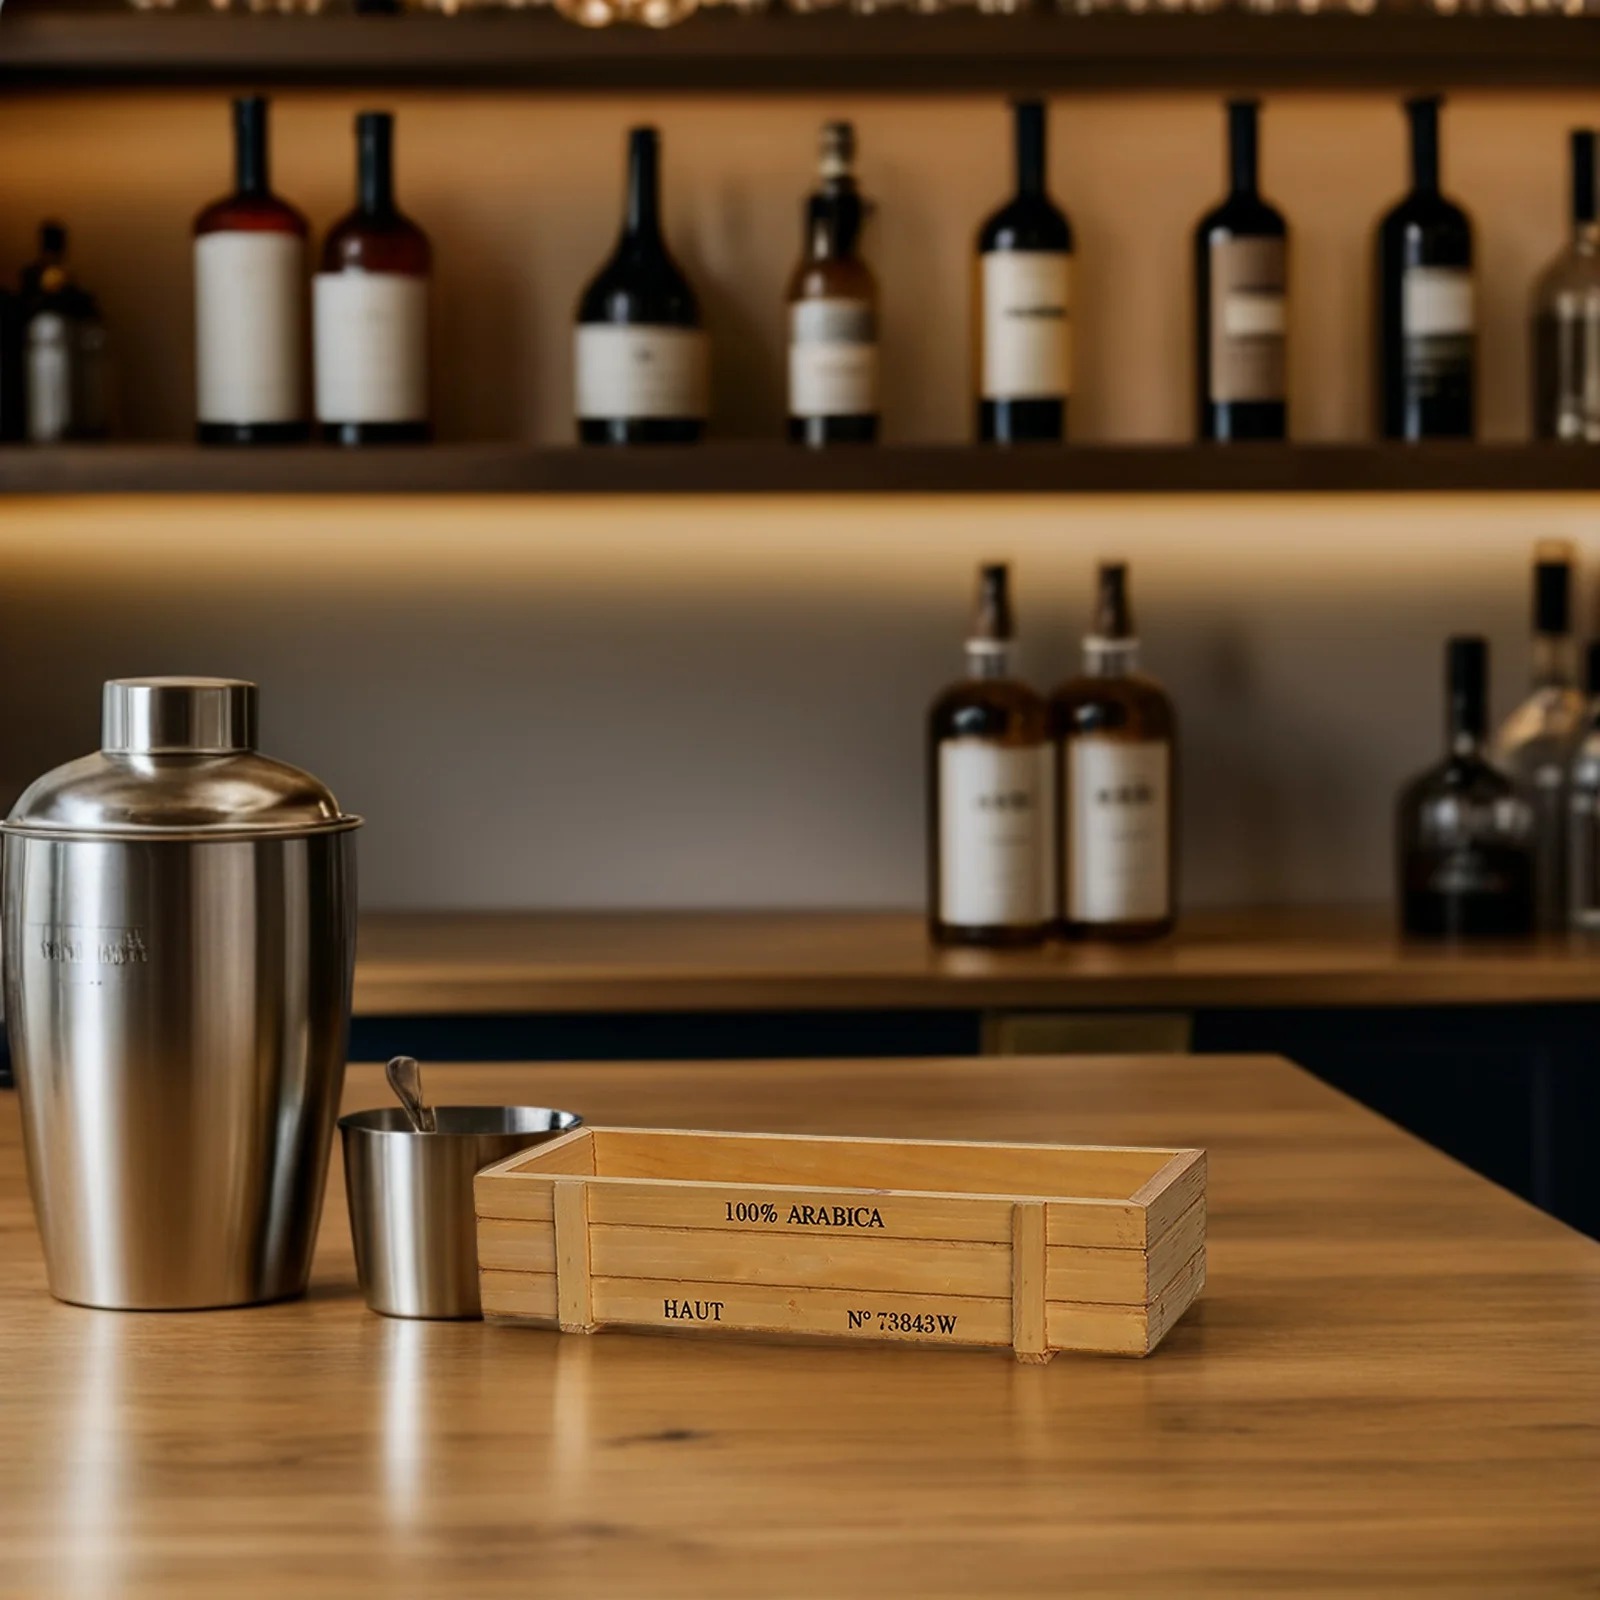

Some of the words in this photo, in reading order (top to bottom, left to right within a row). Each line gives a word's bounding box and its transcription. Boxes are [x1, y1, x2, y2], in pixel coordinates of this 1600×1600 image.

[725, 1201, 778, 1224] 100%
[786, 1204, 885, 1229] ARABICA
[663, 1299, 724, 1321] HAUT
[877, 1312, 957, 1335] 73843W
